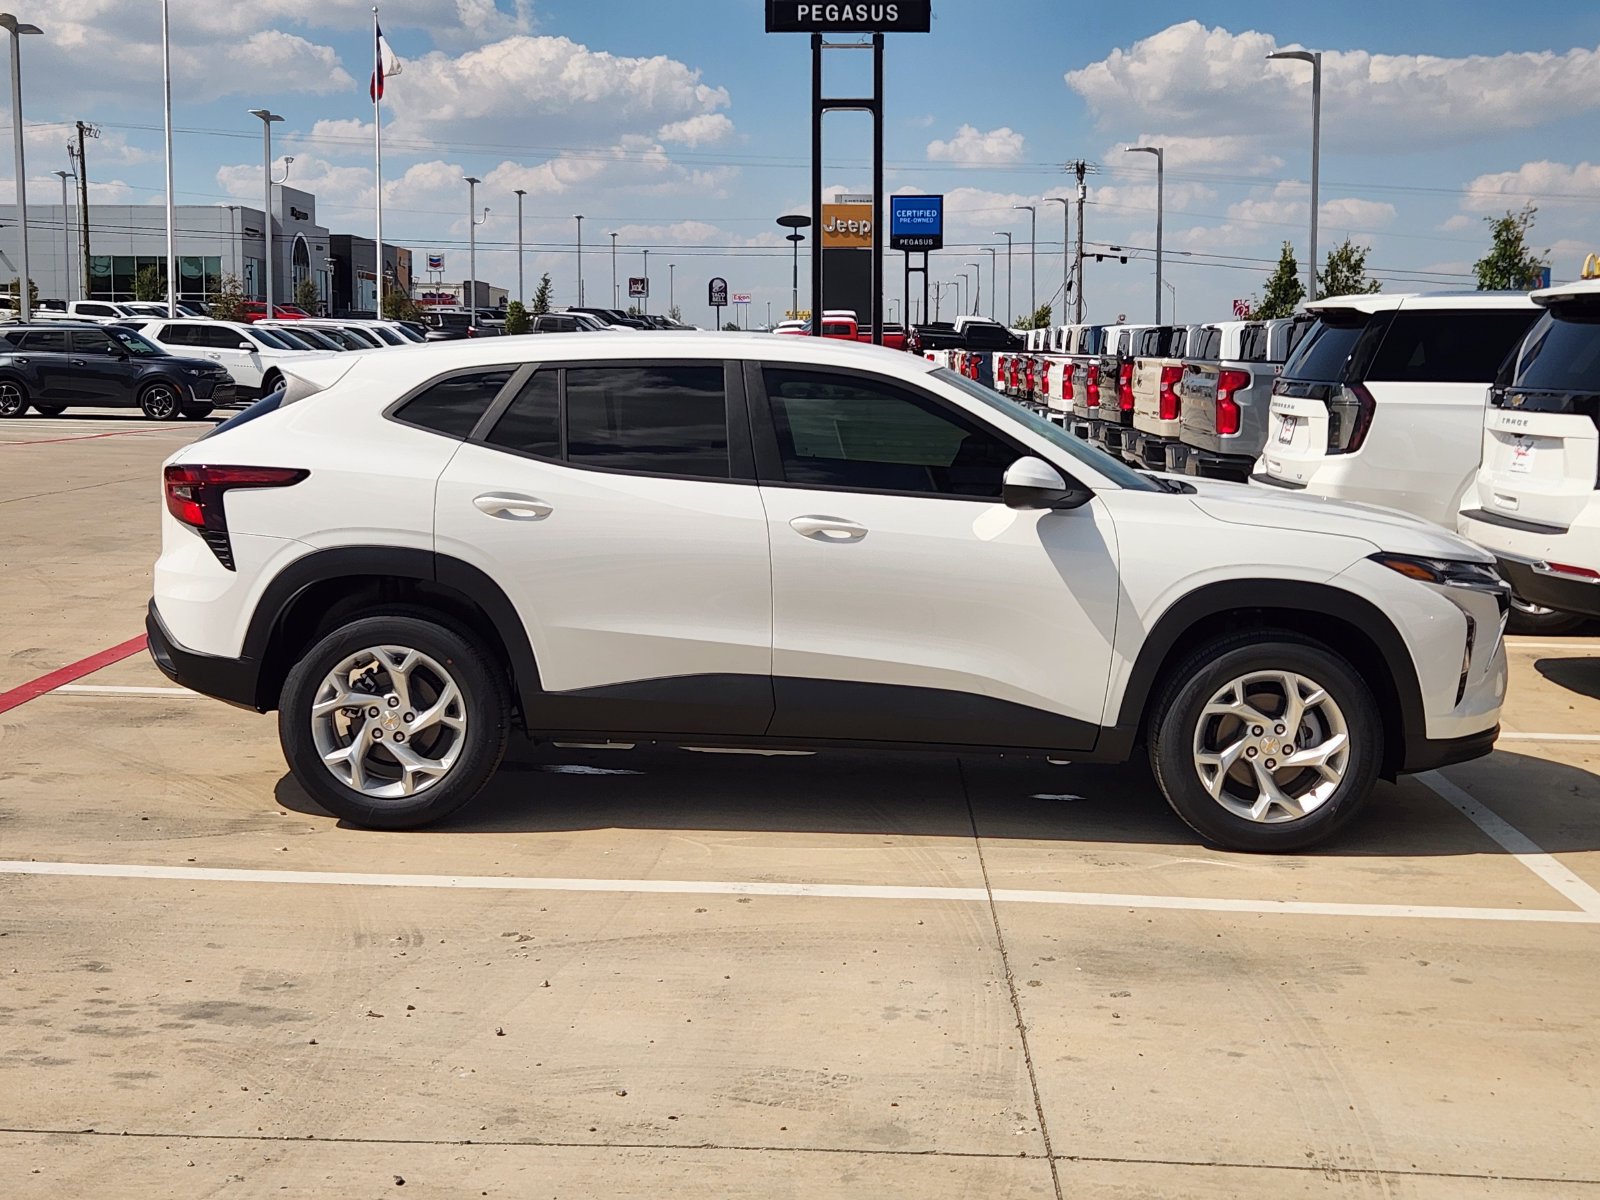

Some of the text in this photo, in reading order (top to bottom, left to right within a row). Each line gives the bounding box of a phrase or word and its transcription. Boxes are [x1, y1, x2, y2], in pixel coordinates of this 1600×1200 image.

[797, 4, 899, 22] PEGASUS
[896, 210, 937, 218] CERTIFIED
[823, 216, 871, 235] Jeep
